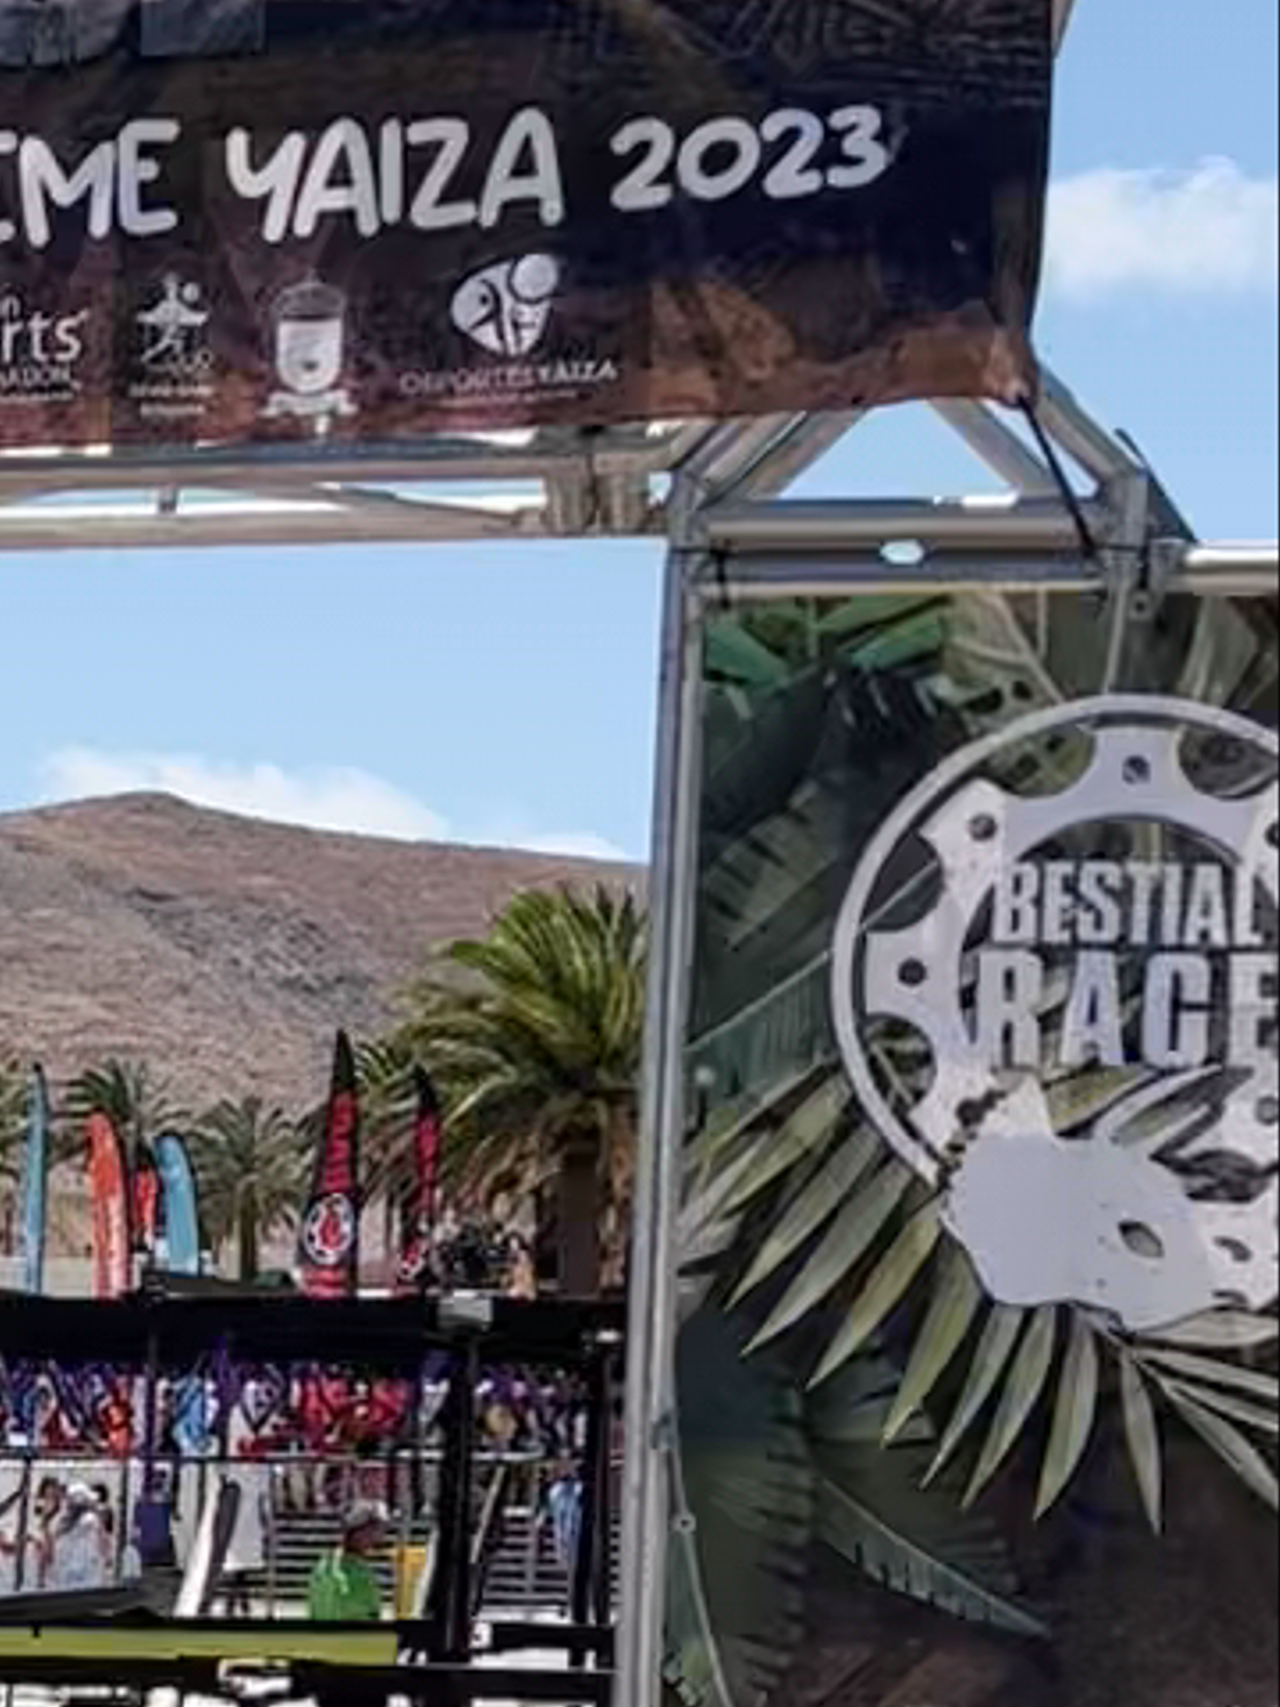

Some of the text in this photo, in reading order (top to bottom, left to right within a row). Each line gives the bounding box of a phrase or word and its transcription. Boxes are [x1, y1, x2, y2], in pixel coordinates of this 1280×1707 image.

[225, 106, 566, 245] YAIZA
[608, 102, 890, 212] 2023
[992, 860, 1268, 948] BESTIAL
